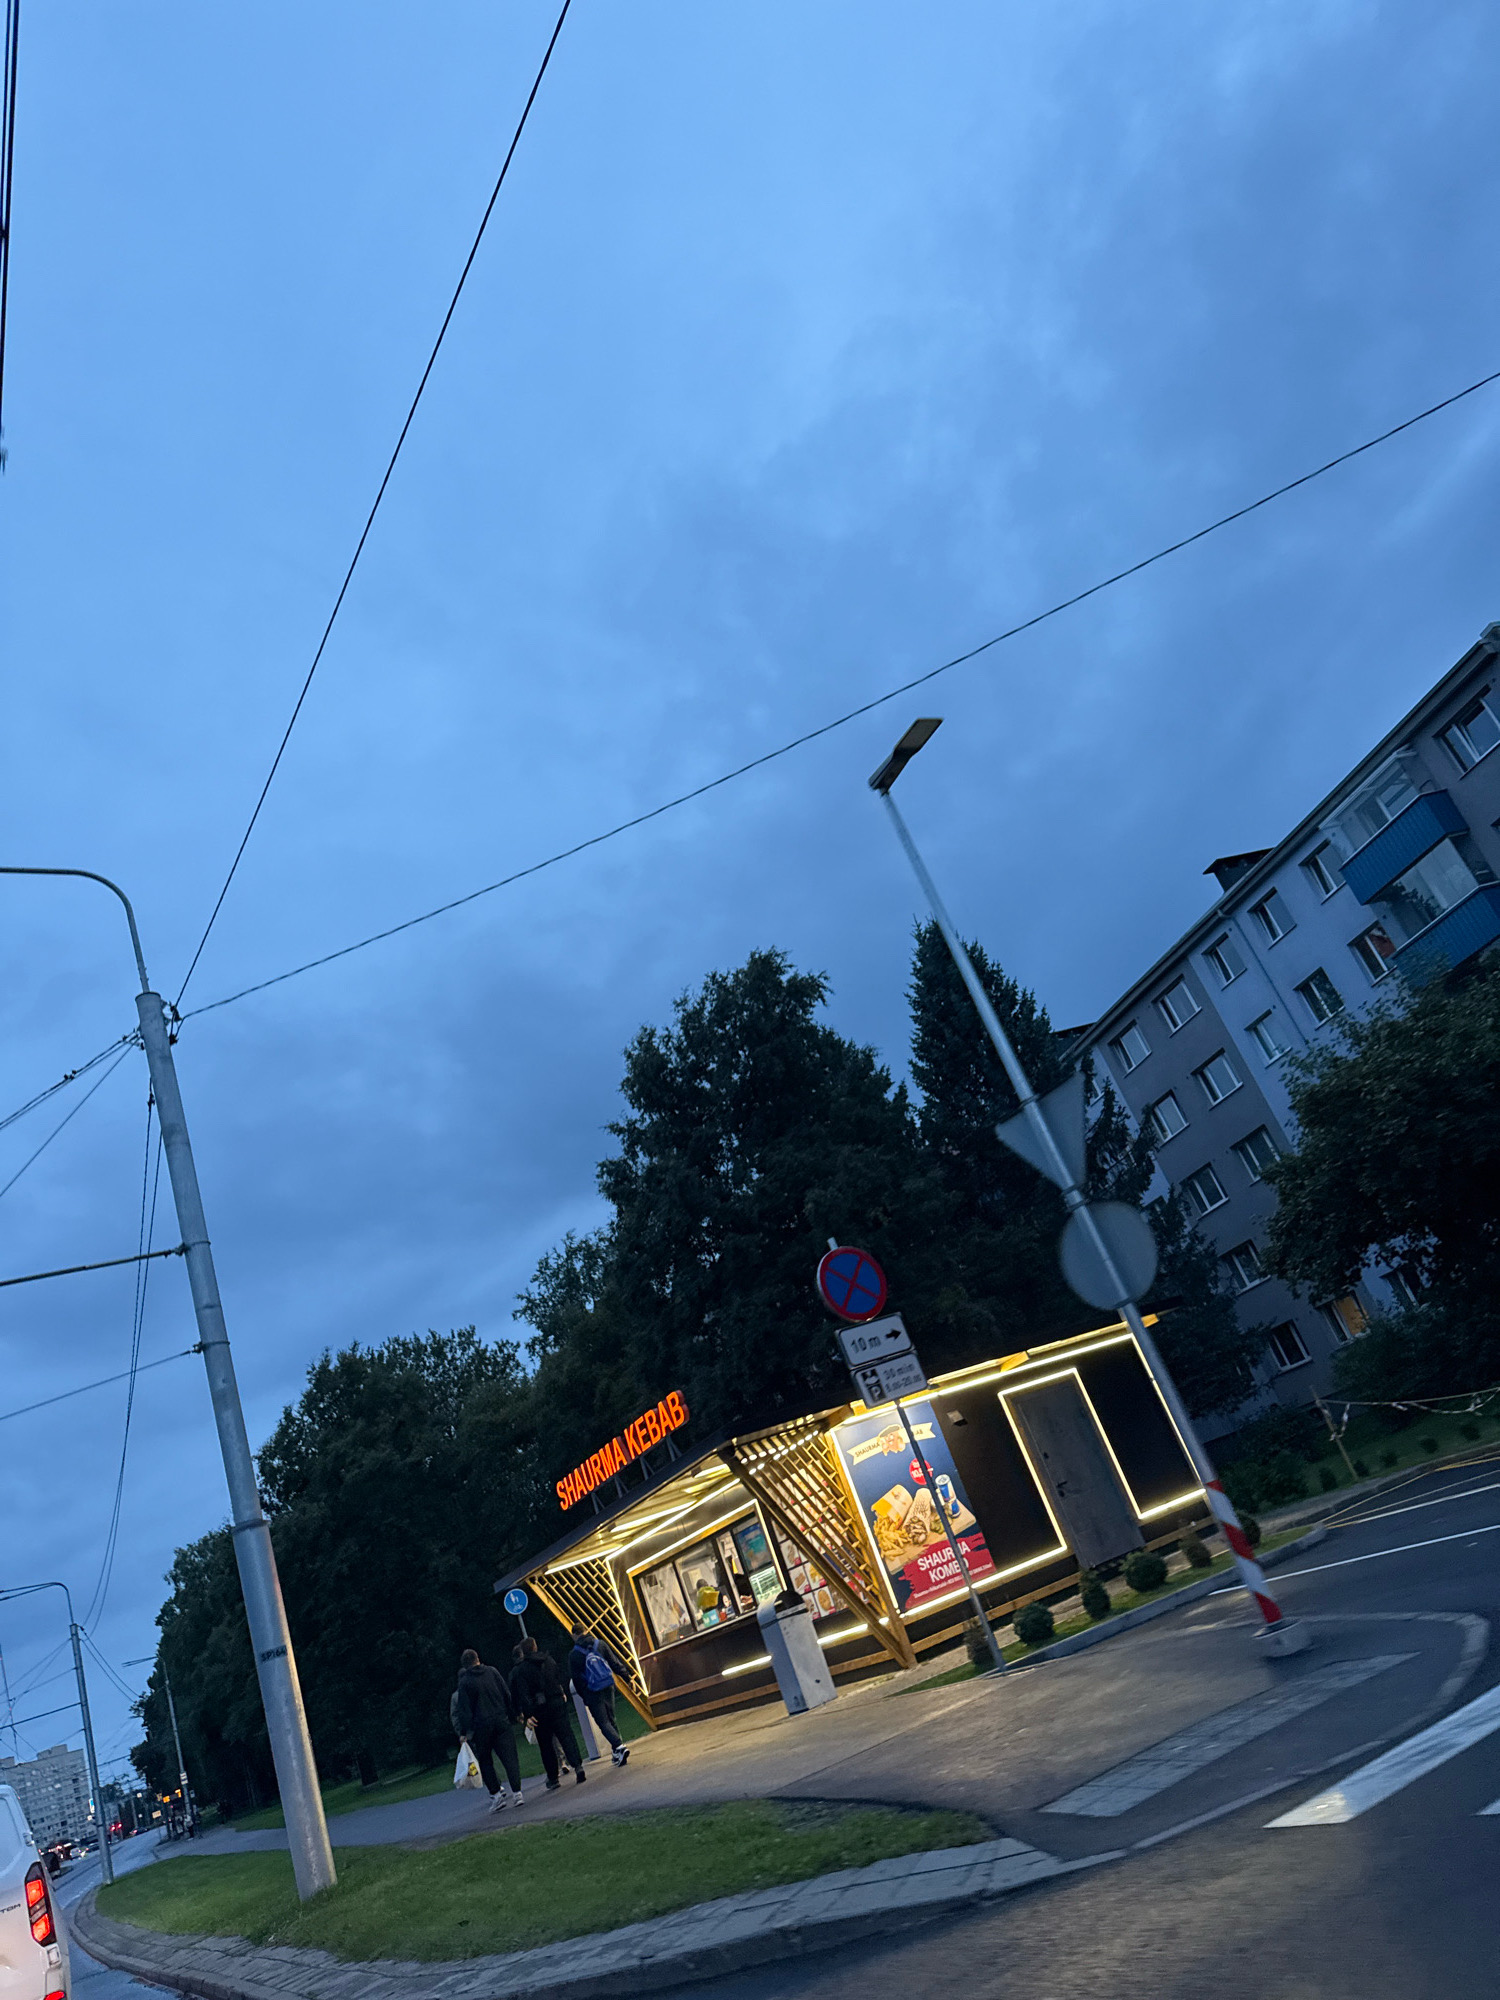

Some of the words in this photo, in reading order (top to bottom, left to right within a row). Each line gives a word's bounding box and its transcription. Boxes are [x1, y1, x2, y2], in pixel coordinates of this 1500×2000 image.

[850, 1335, 868, 1354] 10
[556, 1437, 628, 1511] SHAURMA
[623, 1390, 688, 1460] KEBAB
